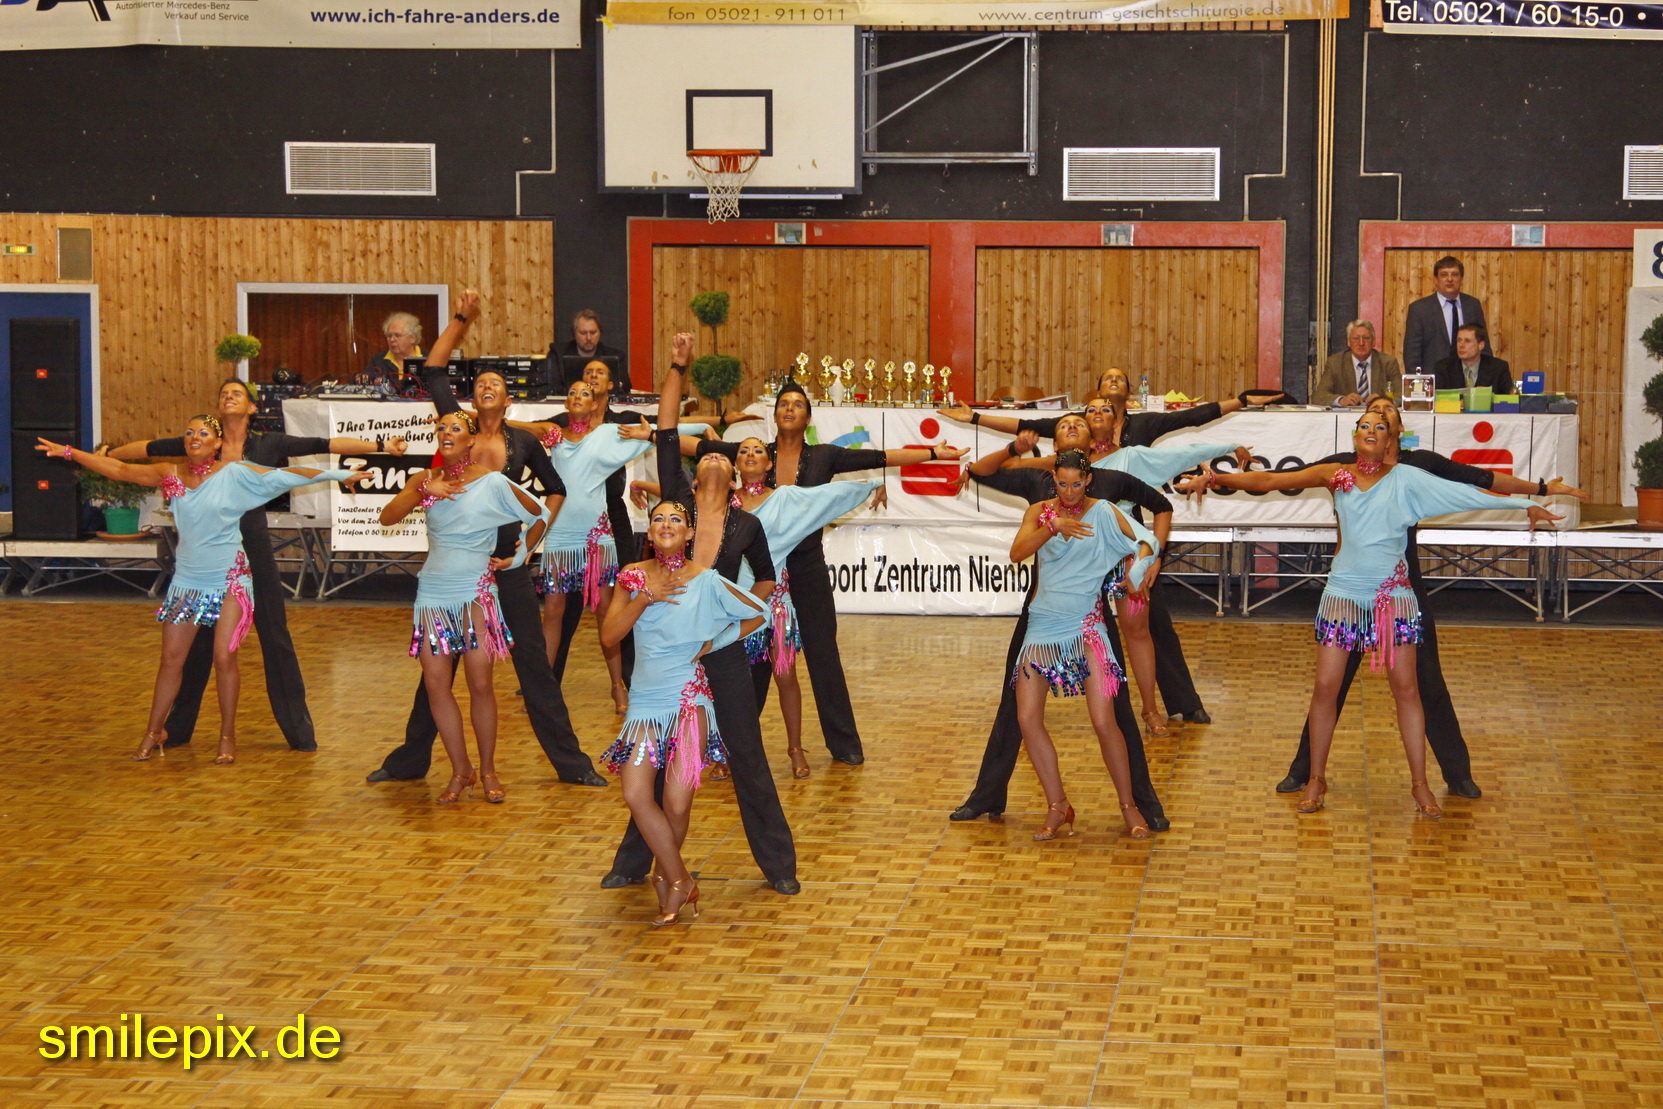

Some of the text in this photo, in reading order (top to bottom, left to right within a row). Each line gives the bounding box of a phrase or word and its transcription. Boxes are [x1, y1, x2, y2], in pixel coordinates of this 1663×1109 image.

[115, 1, 230, 10] Autorisierter Mercedes-Benz
[978, 2, 1286, 22] www.centrum-gesichtschirurgie.de
[165, 12, 249, 21] Verkauf und Service
[310, 9, 560, 24] www.ich-fahre-anders.de
[668, 6, 695, 20] fon
[705, 8, 760, 21] 05021
[775, 8, 806, 21] 911
[813, 8, 845, 21] 011
[1385, 0, 1624, 27] Tel. 05021 / 60 15-0
[337, 420, 365, 434] Ihre
[337, 517, 350, 525] Vor
[351, 517, 366, 525] dem
[337, 528, 364, 537] Telefon
[873, 555, 962, 593] Zentrum
[969, 555, 1034, 593] Nienb
